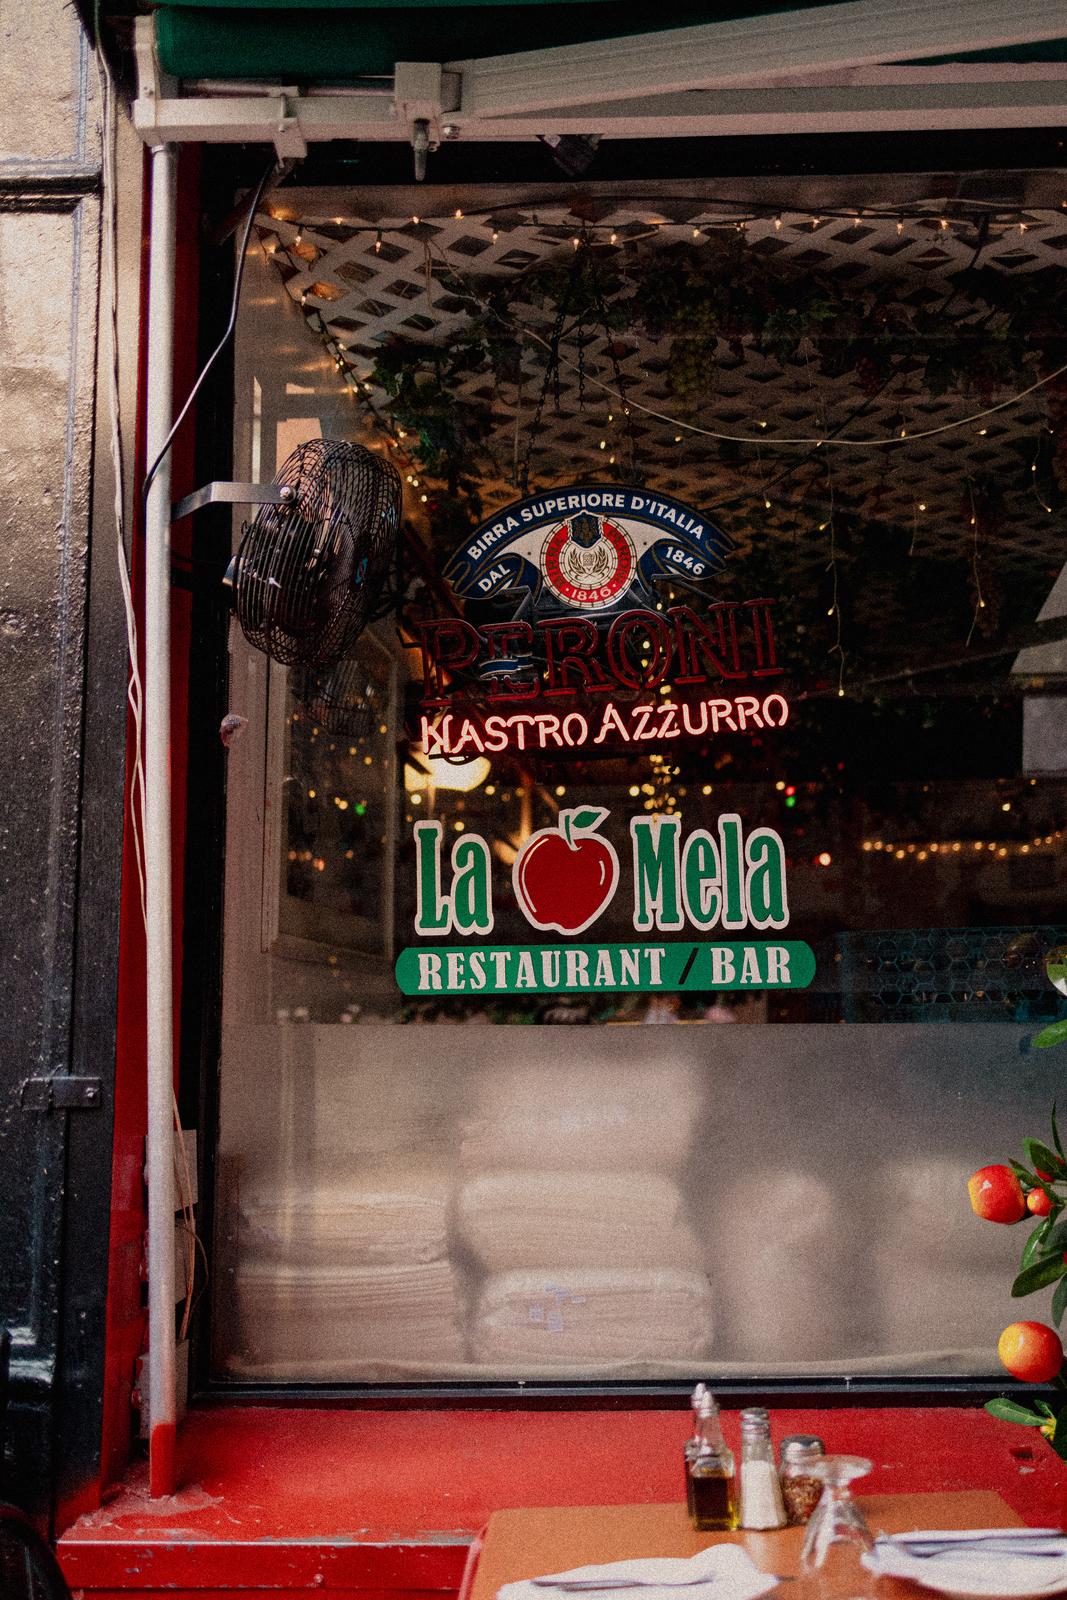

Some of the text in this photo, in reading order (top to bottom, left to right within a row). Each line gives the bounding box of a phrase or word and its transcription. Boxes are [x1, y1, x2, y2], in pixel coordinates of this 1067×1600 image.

[467, 494, 704, 560] BIRRA SUPERIORE D'ITALIA
[478, 546, 706, 592] DAL 1846
[571, 586, 611, 600] 1846
[416, 599, 784, 707] PERONI
[421, 693, 789, 755] NASTRO AZZURRO
[413, 813, 790, 935] La Mela
[418, 948, 665, 990] RESTAURANT
[710, 946, 791, 984] BAR
